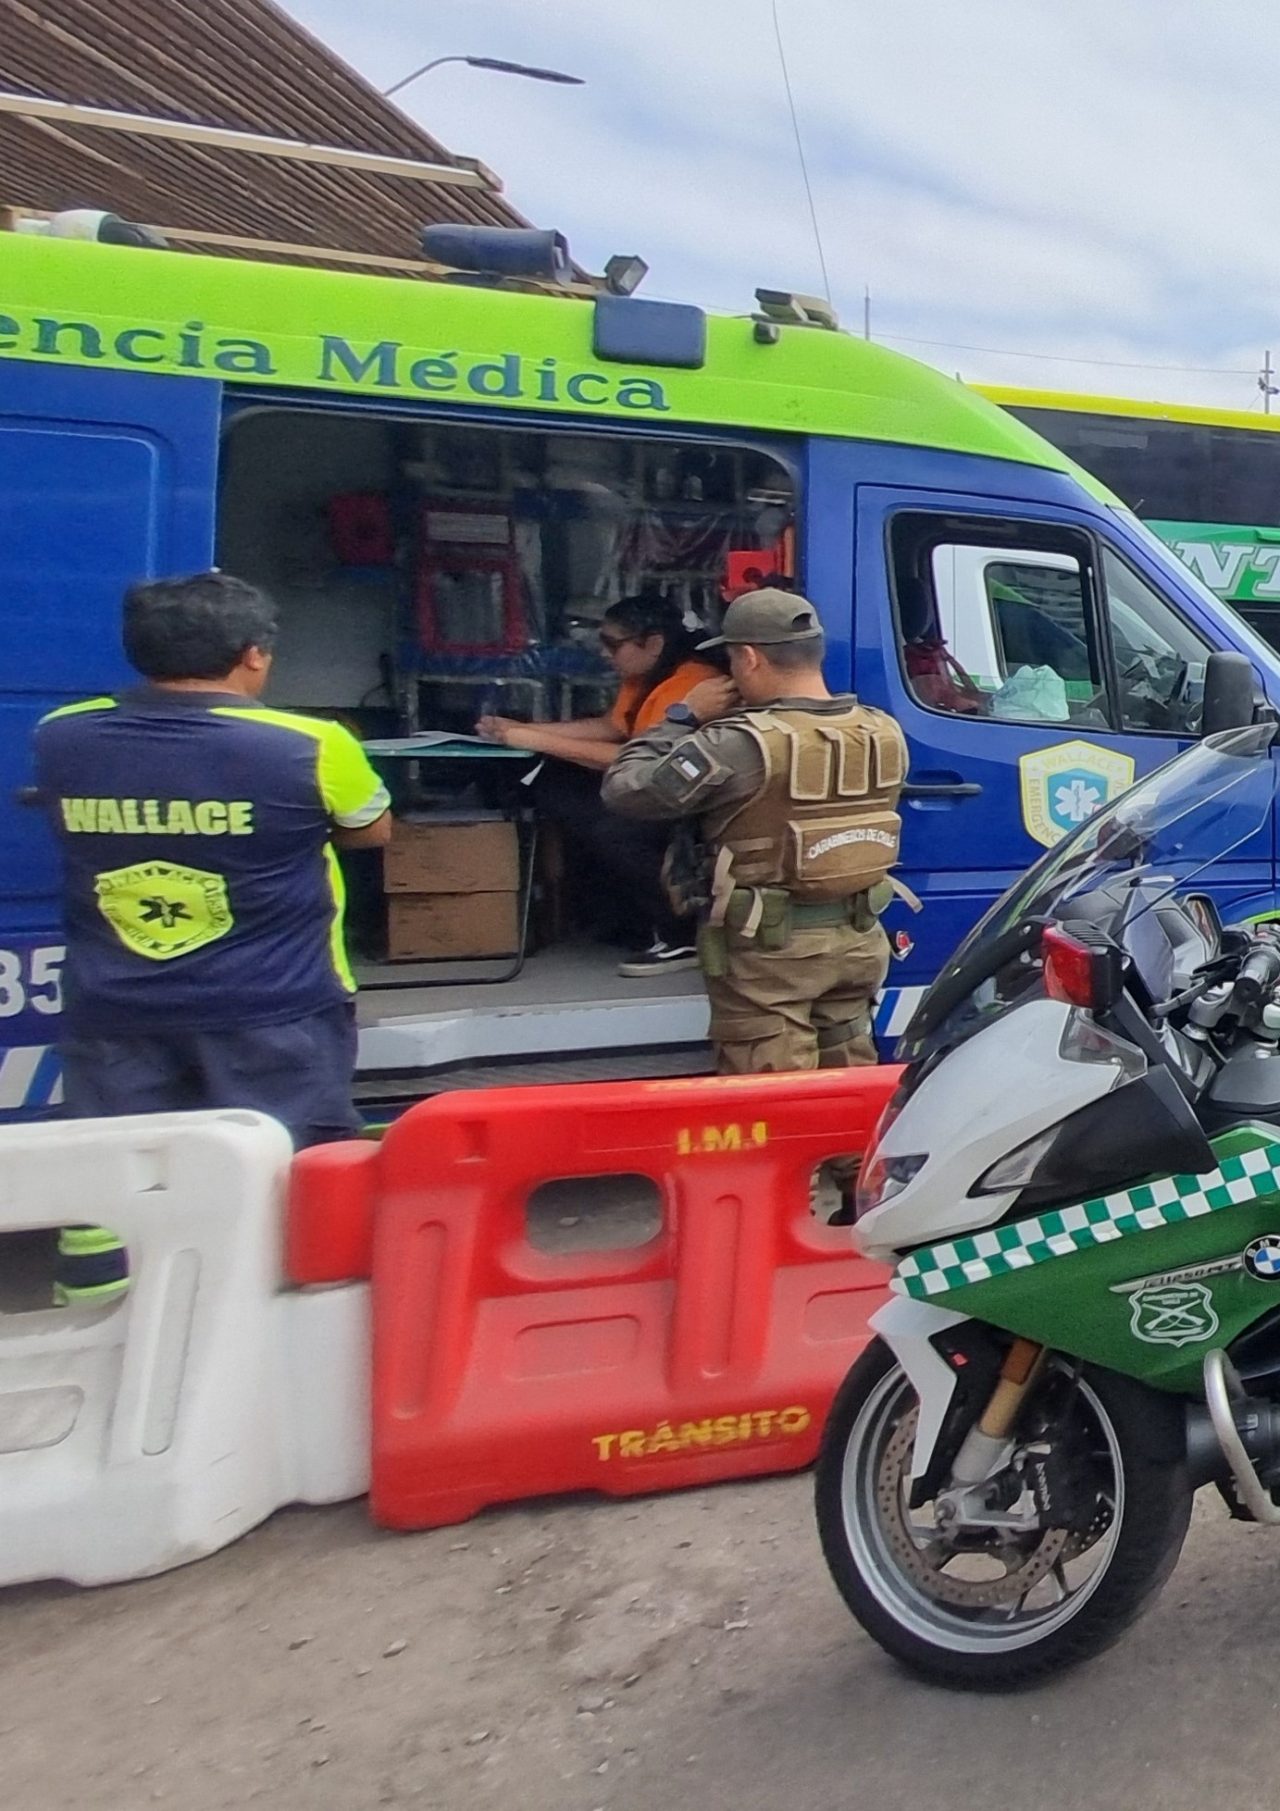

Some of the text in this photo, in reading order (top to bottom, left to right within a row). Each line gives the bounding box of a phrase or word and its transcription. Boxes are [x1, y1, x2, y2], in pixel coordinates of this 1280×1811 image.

[317, 334, 671, 411] Médica
[1042, 751, 1115, 772] WALLACE
[60, 798, 254, 836] WALLACE
[592, 1406, 811, 1461] TRÁNSITO
